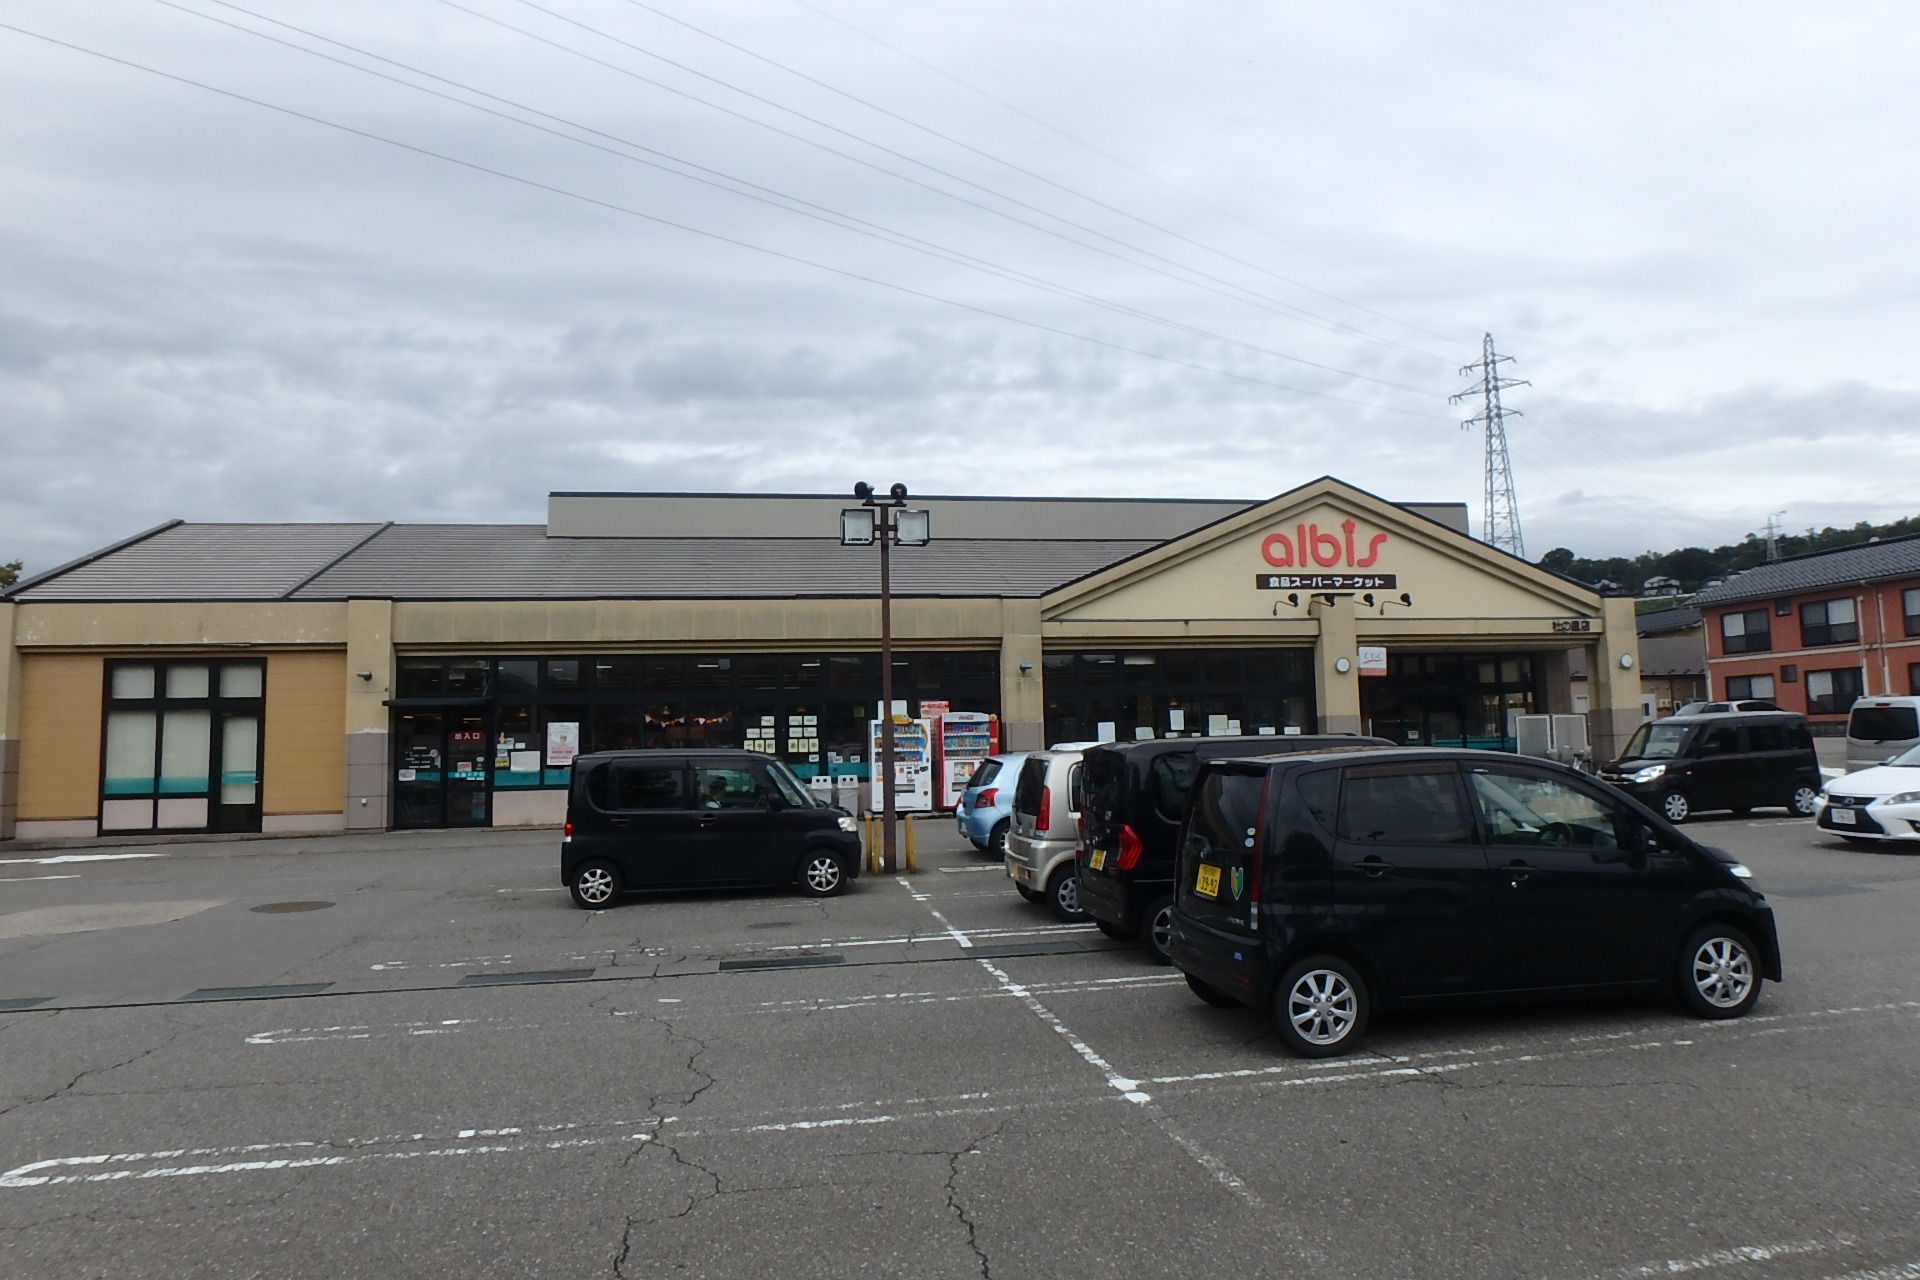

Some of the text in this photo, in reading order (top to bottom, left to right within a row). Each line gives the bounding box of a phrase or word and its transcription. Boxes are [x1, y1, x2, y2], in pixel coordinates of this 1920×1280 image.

[1261, 517, 1388, 567] albis
[1269, 576, 1384, 588] 食品スーパーマーケット
[454, 732, 480, 740] 出入口
